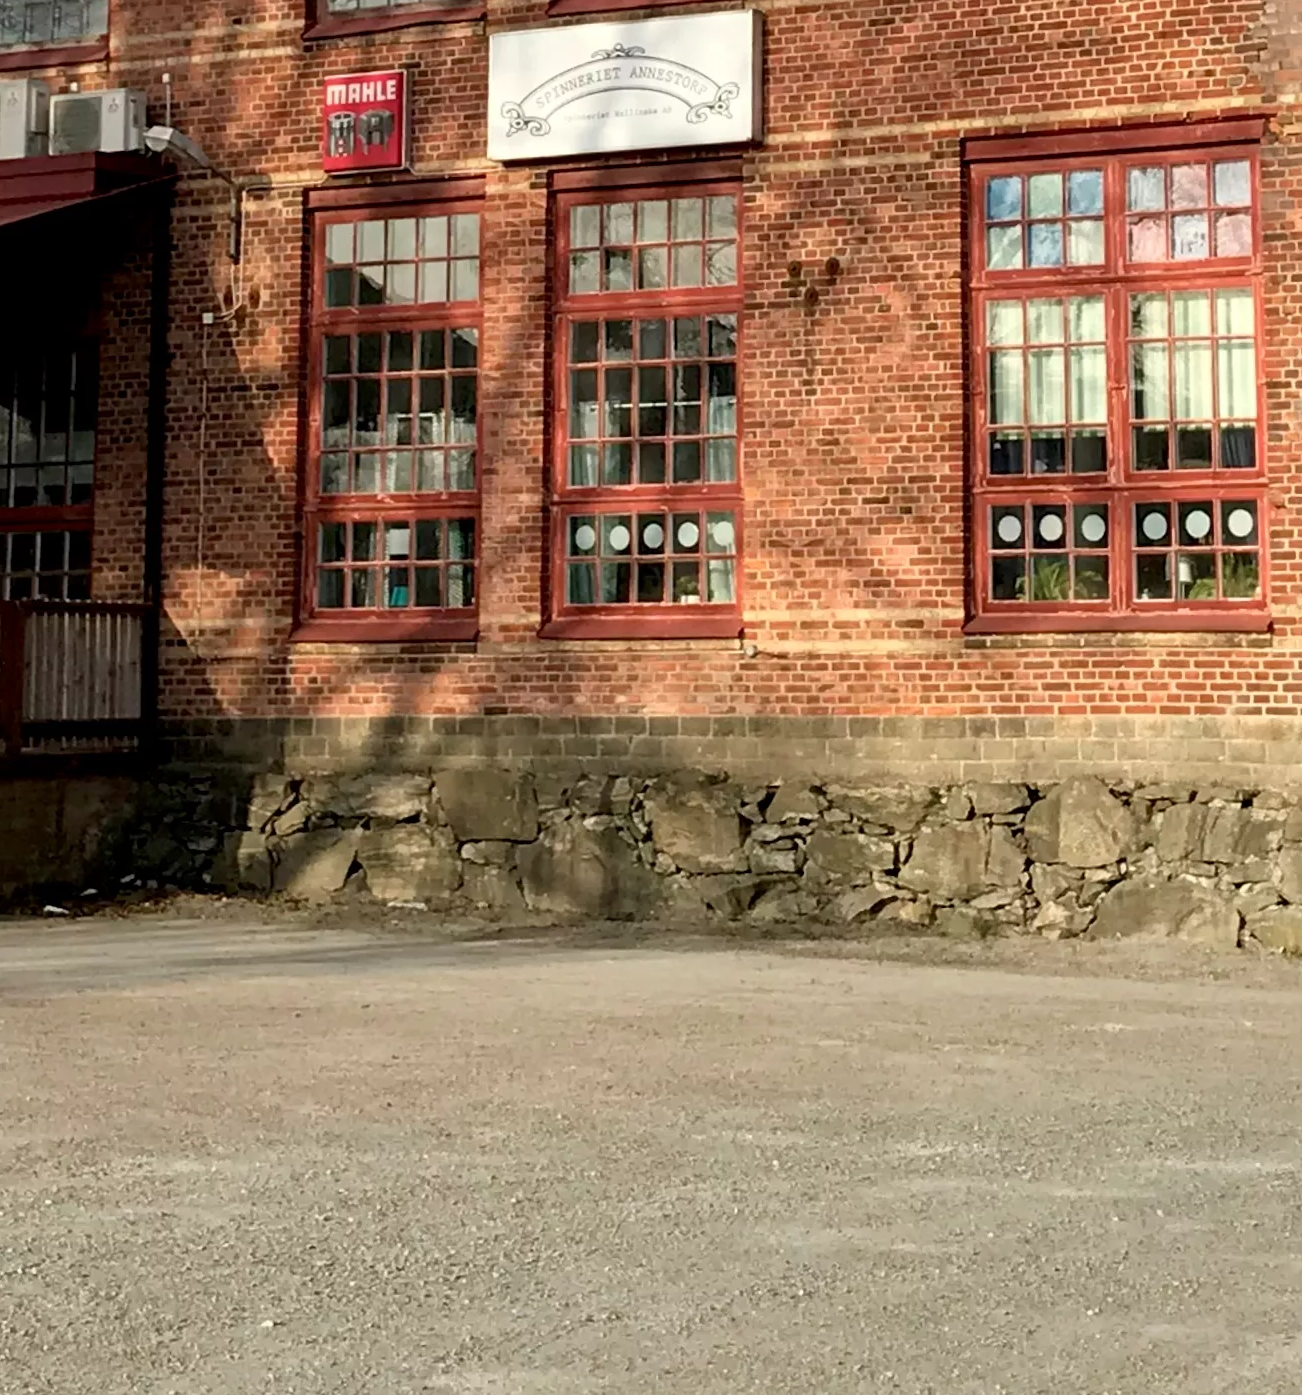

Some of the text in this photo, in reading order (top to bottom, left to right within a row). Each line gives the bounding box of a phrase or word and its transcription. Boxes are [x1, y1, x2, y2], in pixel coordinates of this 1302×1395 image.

[326, 79, 397, 106] MAHLE
[536, 66, 708, 109] SPINNERIET ANNESTORP
